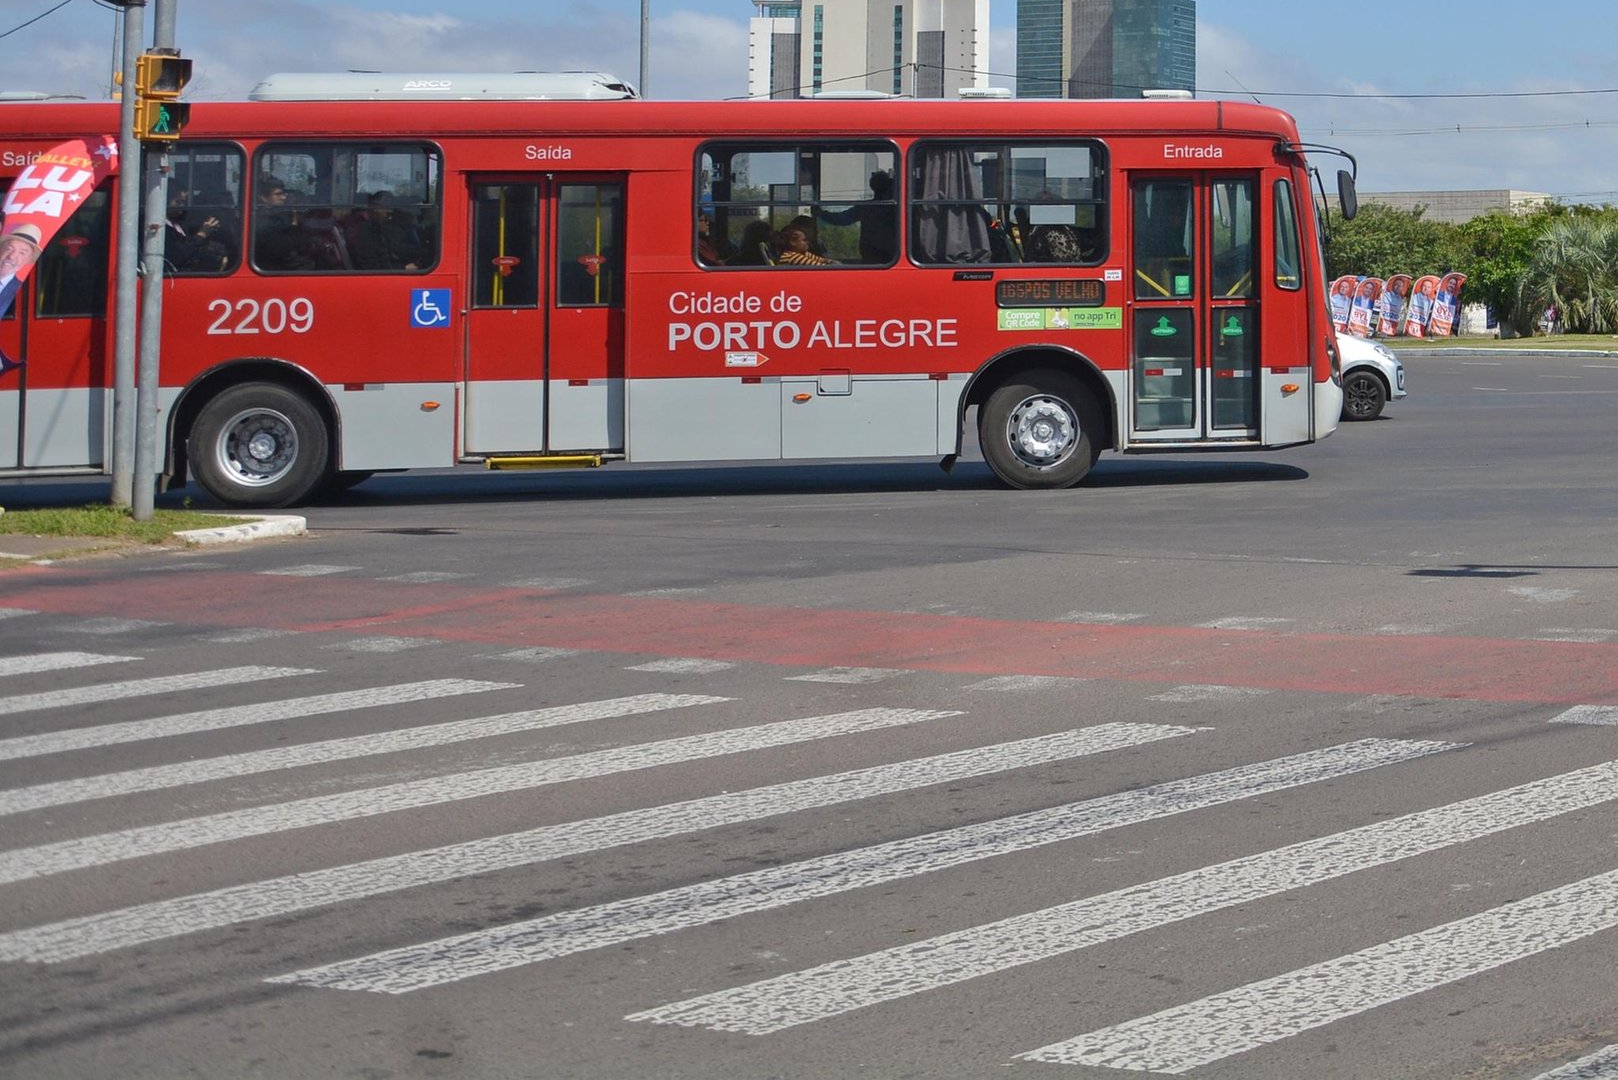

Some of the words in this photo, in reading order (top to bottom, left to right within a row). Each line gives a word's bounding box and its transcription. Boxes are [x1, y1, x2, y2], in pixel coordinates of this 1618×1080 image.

[405, 80, 452, 88] ARCO
[2, 151, 43, 166] Saíd
[525, 144, 572, 160] Saída
[1163, 144, 1223, 158] Entrada
[13, 165, 92, 192] LU
[3, 190, 65, 217] LA
[1055, 281, 1100, 299] VELHO
[669, 291, 761, 314] Cidade
[770, 290, 802, 313] de
[207, 297, 314, 334] 2209
[1005, 311, 1040, 322] Compre
[1087, 313, 1103, 322] app
[1104, 311, 1117, 320] Tri
[1005, 320, 1021, 330] QR
[1022, 319, 1041, 329] Code
[668, 321, 800, 351] PORTO
[807, 318, 959, 349] ALEGRE
